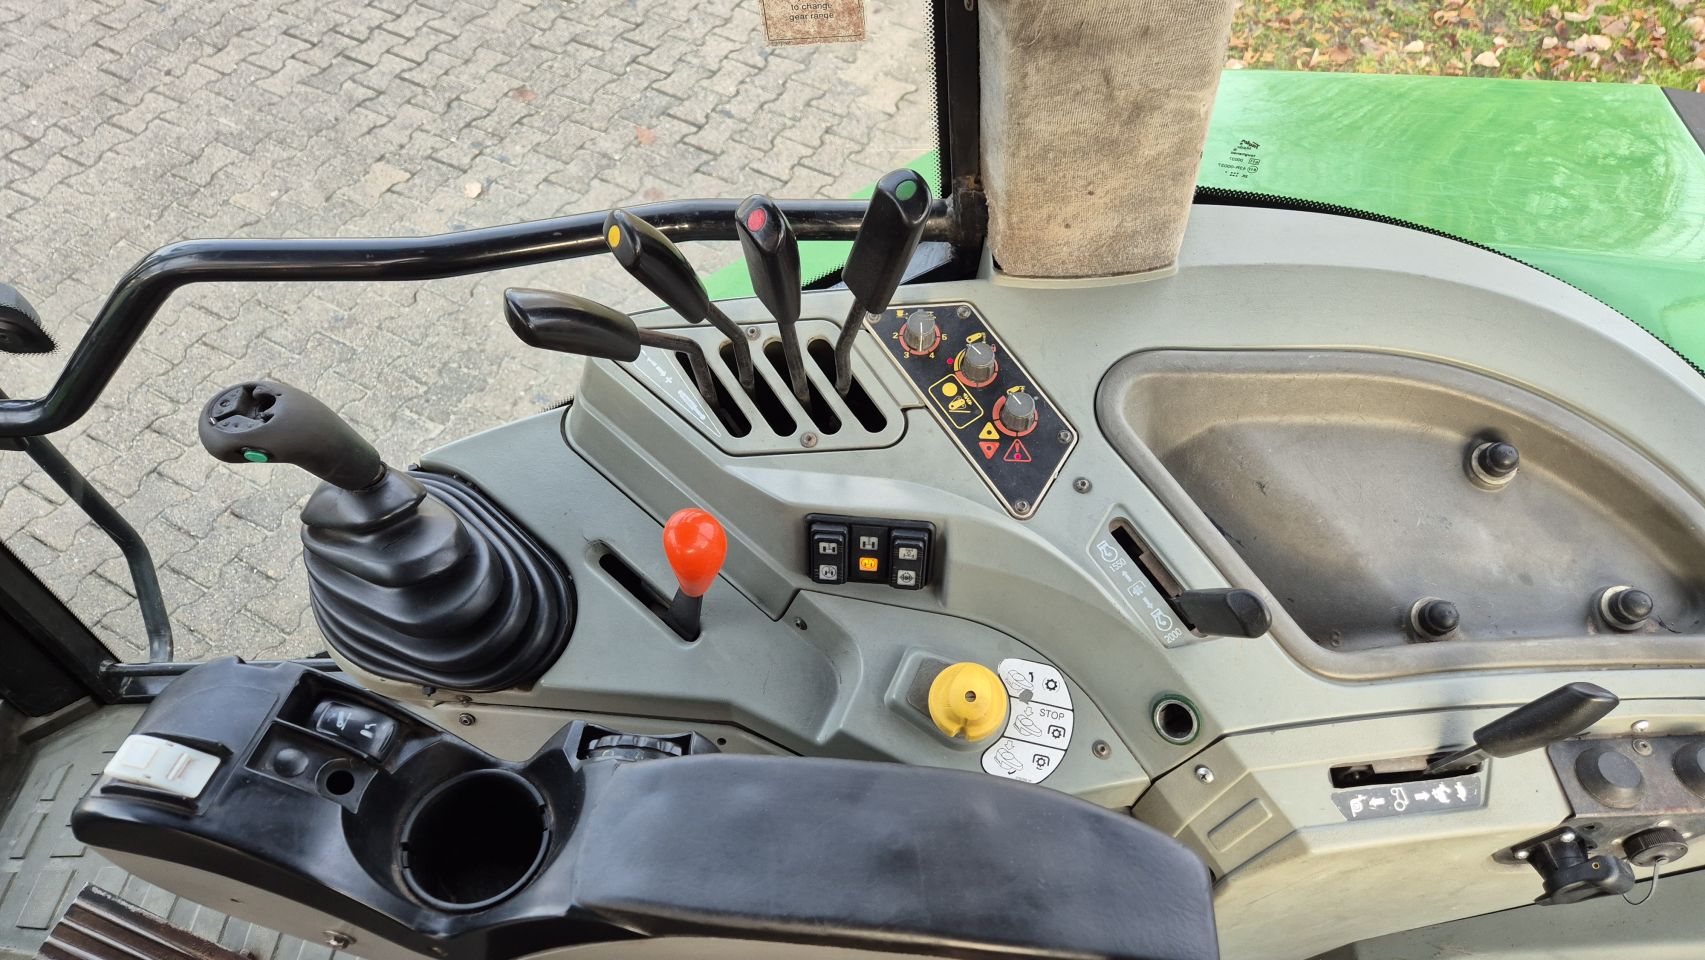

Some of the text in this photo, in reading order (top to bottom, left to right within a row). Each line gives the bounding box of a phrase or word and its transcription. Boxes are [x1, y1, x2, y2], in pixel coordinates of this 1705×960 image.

[789, 14, 807, 22] gear
[1109, 557, 1127, 572] 1550
[1164, 627, 1182, 643] 2000
[1039, 708, 1065, 720] STOP
